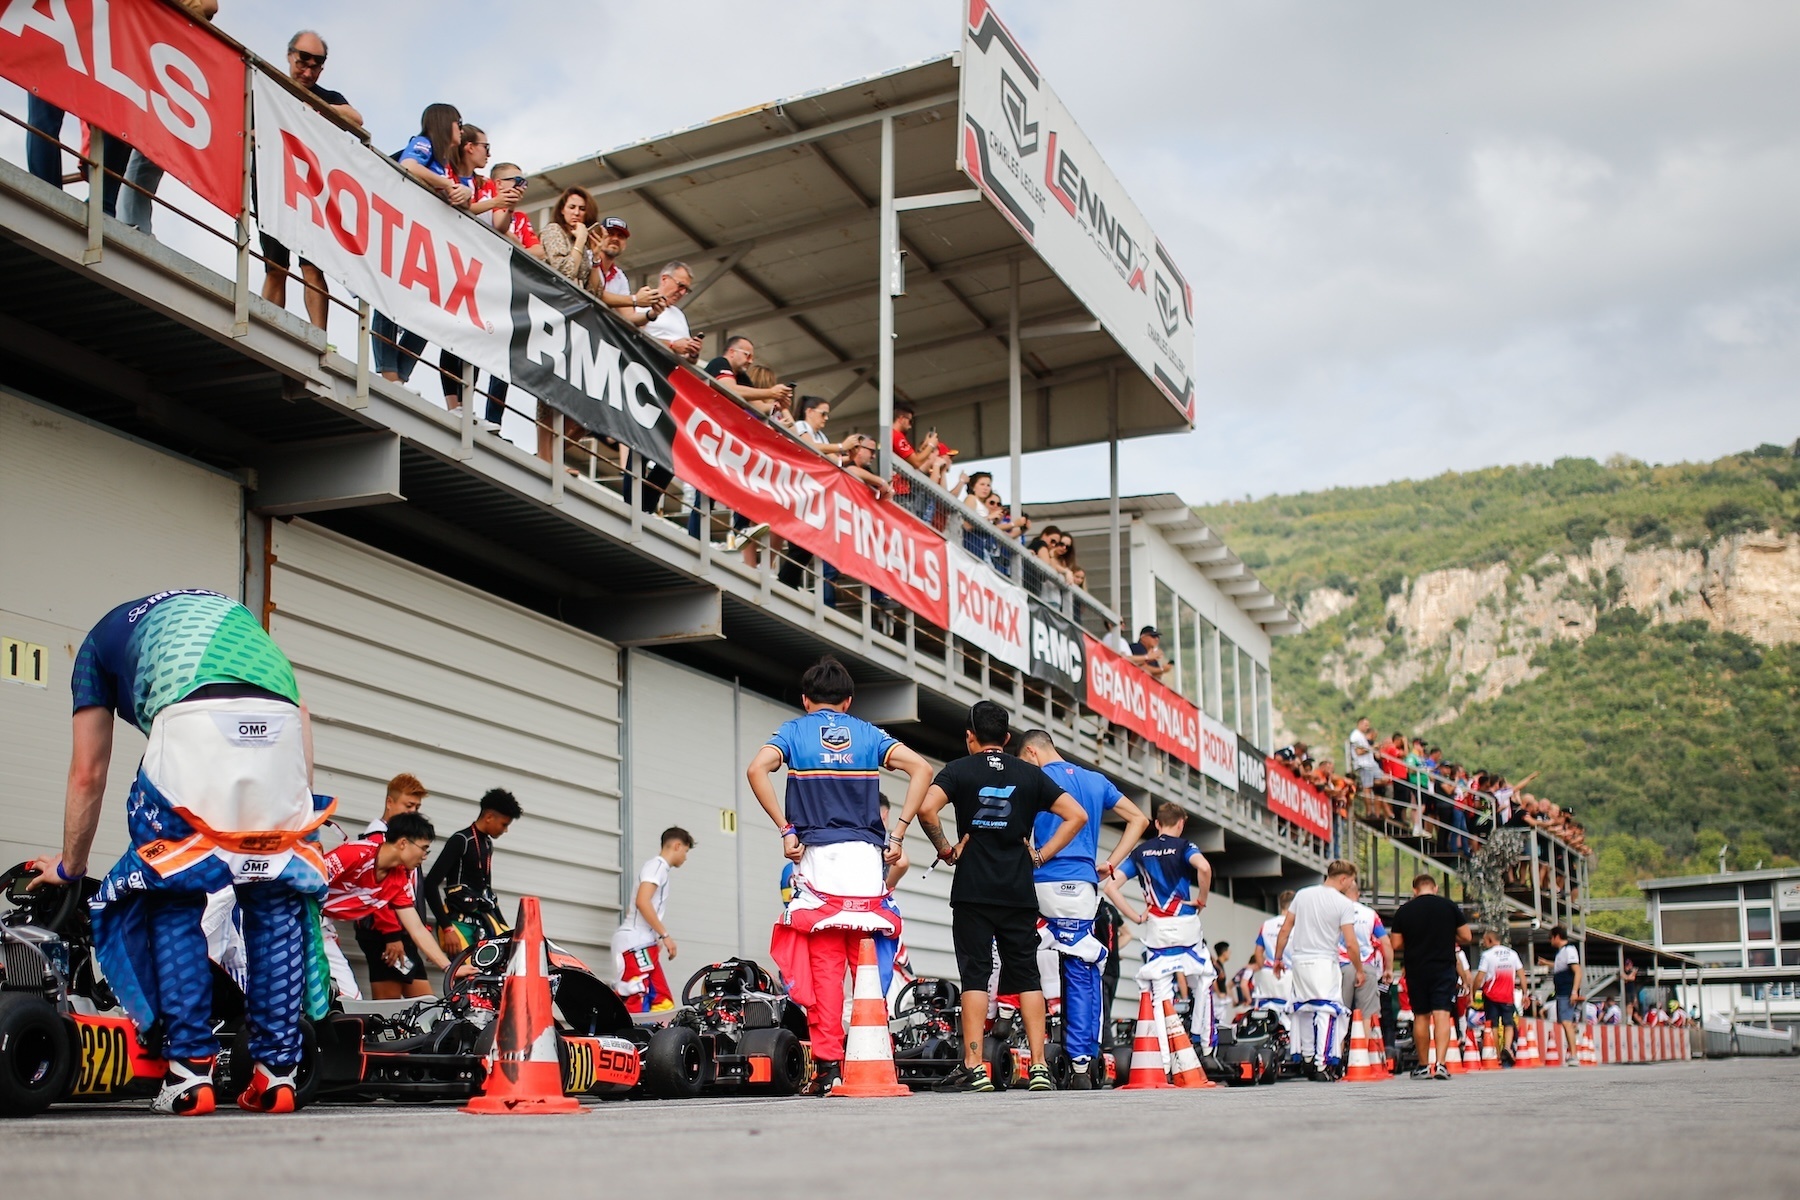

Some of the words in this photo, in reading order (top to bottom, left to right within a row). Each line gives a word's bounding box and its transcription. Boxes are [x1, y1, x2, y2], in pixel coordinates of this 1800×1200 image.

[989, 130, 1019, 180] CHARLES
[1045, 130, 1150, 295] LENNOX
[1077, 215, 1127, 280] RACING
[279, 128, 486, 331] ROTAX
[527, 293, 663, 430] RMC
[686, 407, 827, 531] GRAND
[833, 490, 942, 602] FINALS
[9, 642, 41, 682] 11
[956, 568, 1023, 648] ROTAX
[1032, 617, 1083, 683] RMC
[1091, 655, 1147, 721] GRAND
[1149, 691, 1197, 753] FINALS
[239, 725, 267, 735] OMP
[1203, 728, 1235, 774] ROTAX
[1239, 749, 1266, 793] RMC
[143, 843, 166, 860] OMP
[242, 862, 269, 872] OMP
[1142, 849, 1163, 858] TEAM
[1163, 848, 1177, 856] UK
[78, 1023, 129, 1093] 320
[568, 1041, 593, 1091] 310
